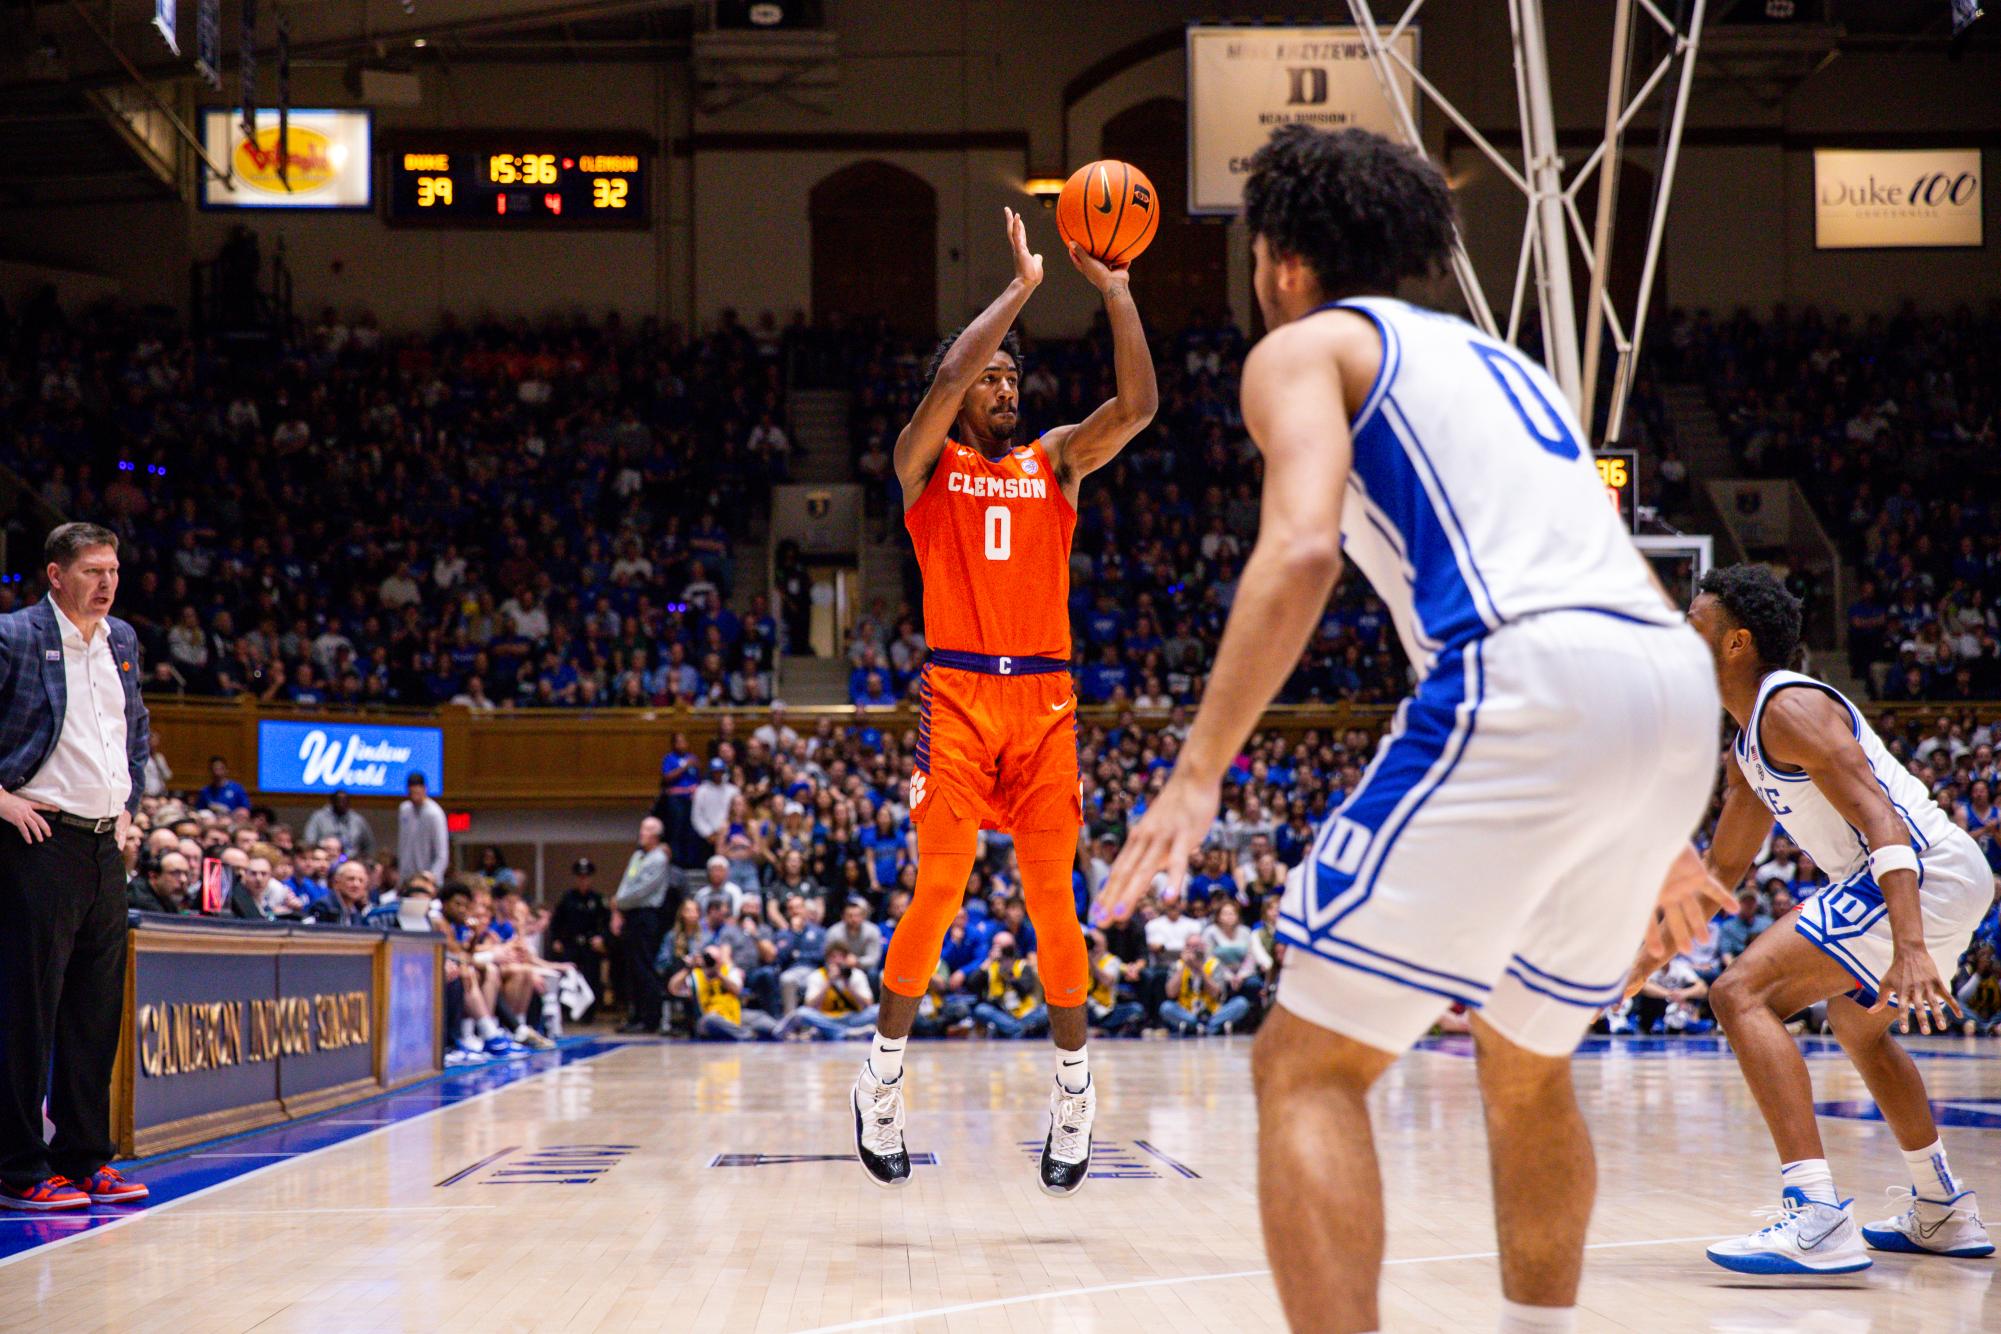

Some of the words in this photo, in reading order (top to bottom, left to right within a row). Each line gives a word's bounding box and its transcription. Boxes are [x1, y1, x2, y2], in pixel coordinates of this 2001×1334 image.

[490, 153, 557, 184] 15:36
[417, 177, 452, 207] 39
[593, 178, 628, 208] 32
[1822, 174, 1903, 206] Duke
[1908, 172, 1977, 207] 100
[1467, 339, 1581, 463] 0
[948, 471, 1047, 499] CLEMSON
[985, 505, 1012, 561] 0
[999, 656, 1012, 675] C
[299, 730, 412, 786] Window
